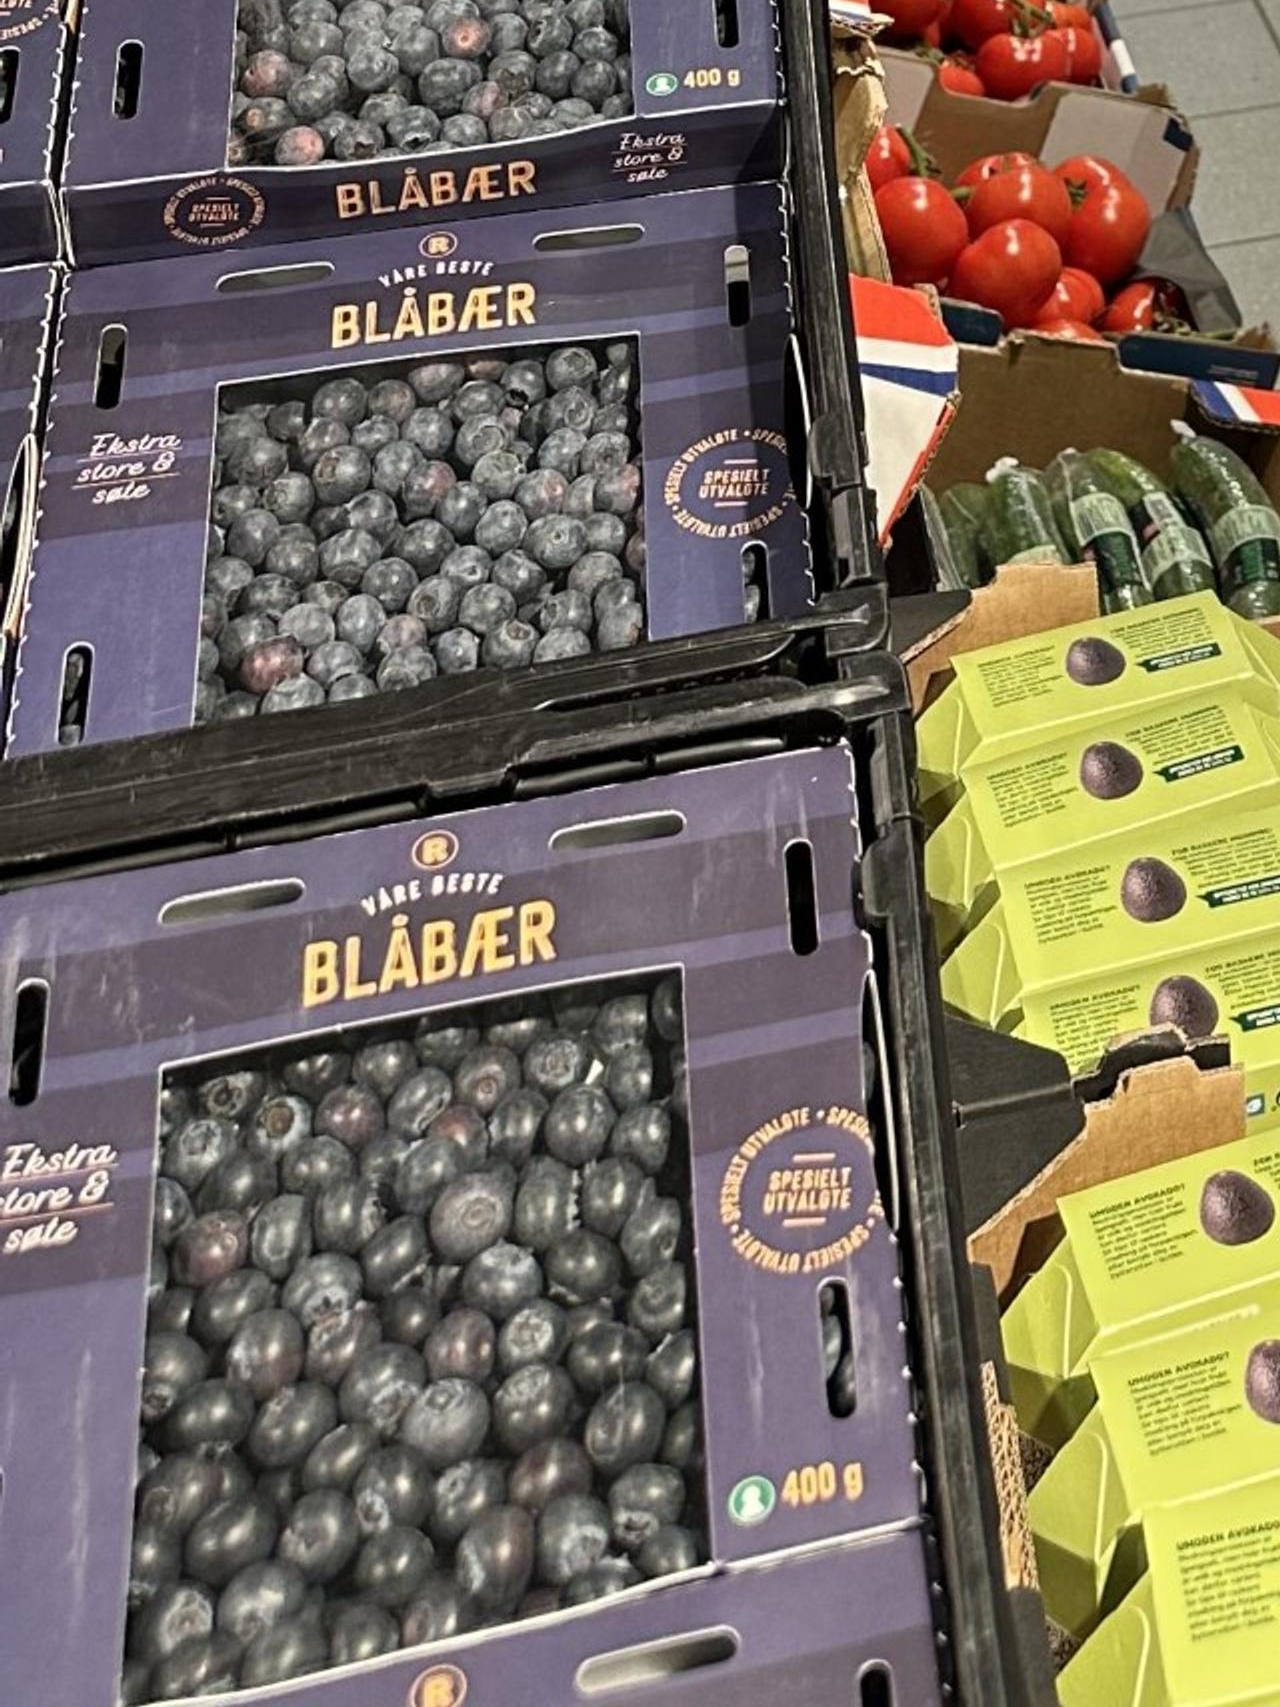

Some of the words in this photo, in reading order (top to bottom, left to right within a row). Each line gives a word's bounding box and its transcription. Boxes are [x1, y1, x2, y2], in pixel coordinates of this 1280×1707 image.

[683, 68, 722, 89] 400
[727, 69, 741, 87] g
[619, 132, 687, 150] Ekstra
[613, 151, 667, 169] store
[336, 160, 538, 219] BLÅBÆR
[378, 264, 428, 288] VÅRE
[435, 260, 496, 277] BESTE
[330, 284, 538, 349] BLÅBÆR
[90, 433, 182, 457] Ekstra
[76, 461, 148, 483] store
[703, 468, 770, 484] SPESIELT
[360, 879, 422, 917] VÅRE
[431, 872, 504, 896] BESTE
[302, 899, 558, 1009] BLÅBÆR
[2, 1142, 117, 1181] Ekstra
[768, 1167, 852, 1191] SPESIELT
[763, 1188, 852, 1215] UTVALGTE
[2, 1215, 79, 1255] søte
[781, 1460, 836, 1508] 400
[843, 1460, 864, 1502] g
